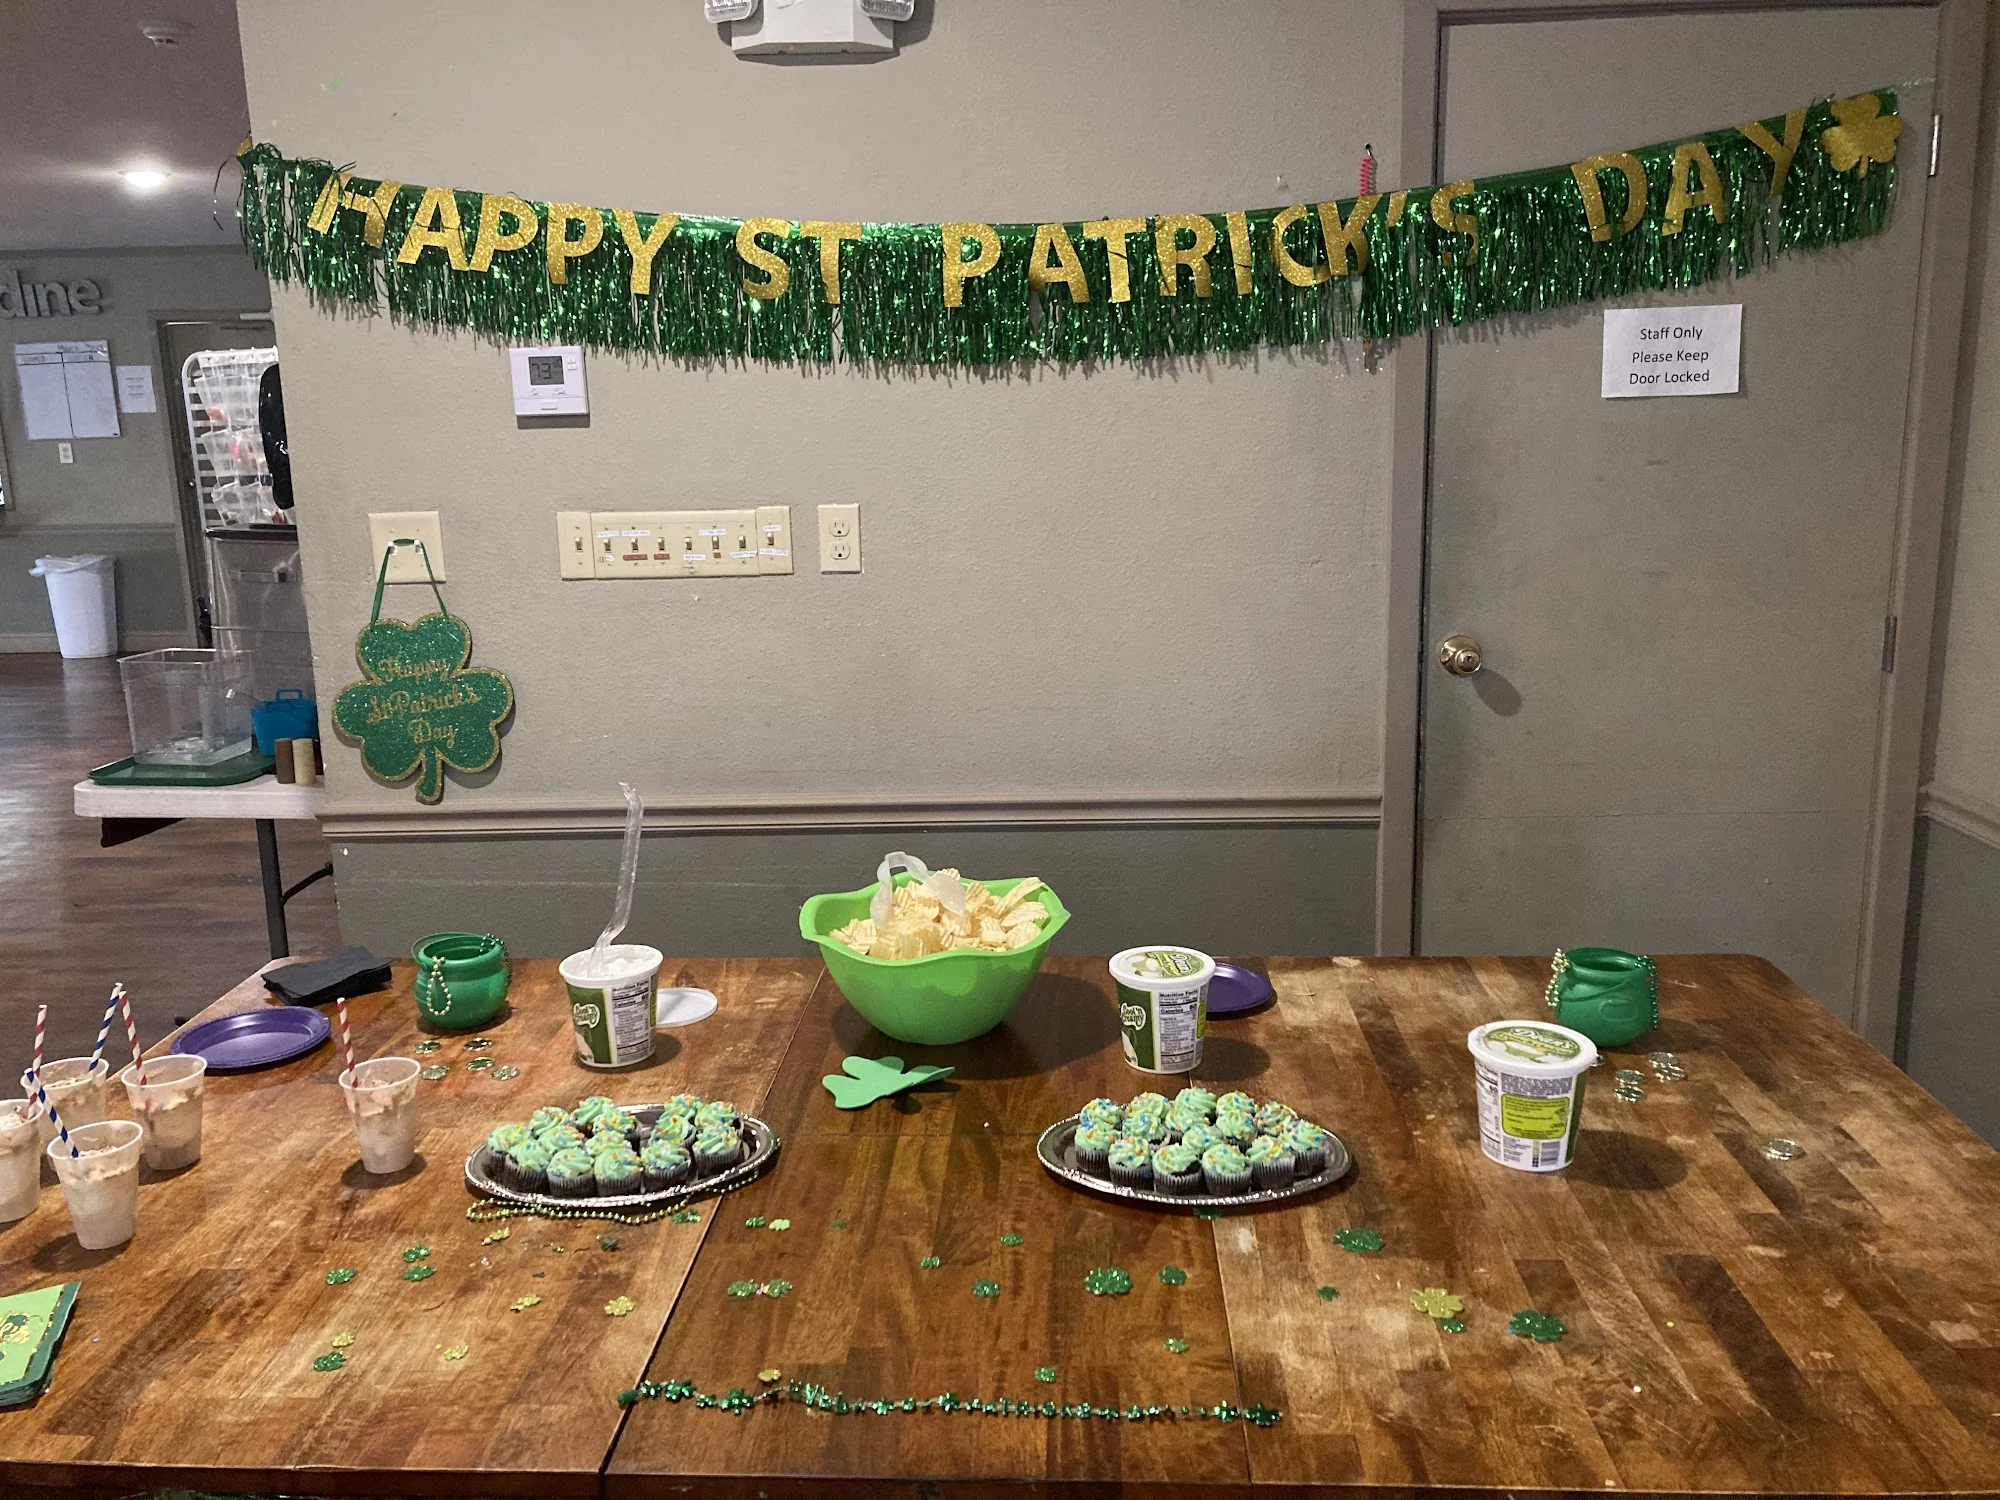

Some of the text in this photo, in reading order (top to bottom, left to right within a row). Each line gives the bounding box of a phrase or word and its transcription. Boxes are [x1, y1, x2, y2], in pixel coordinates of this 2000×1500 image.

[308, 109, 1808, 308] HAPPY ST PATRICK'S DAY
[1640, 326, 1703, 340] Staff Only
[1632, 350, 1709, 363] Please Keep
[531, 362, 552, 380] 73
[1629, 370, 1710, 385] Door Locked
